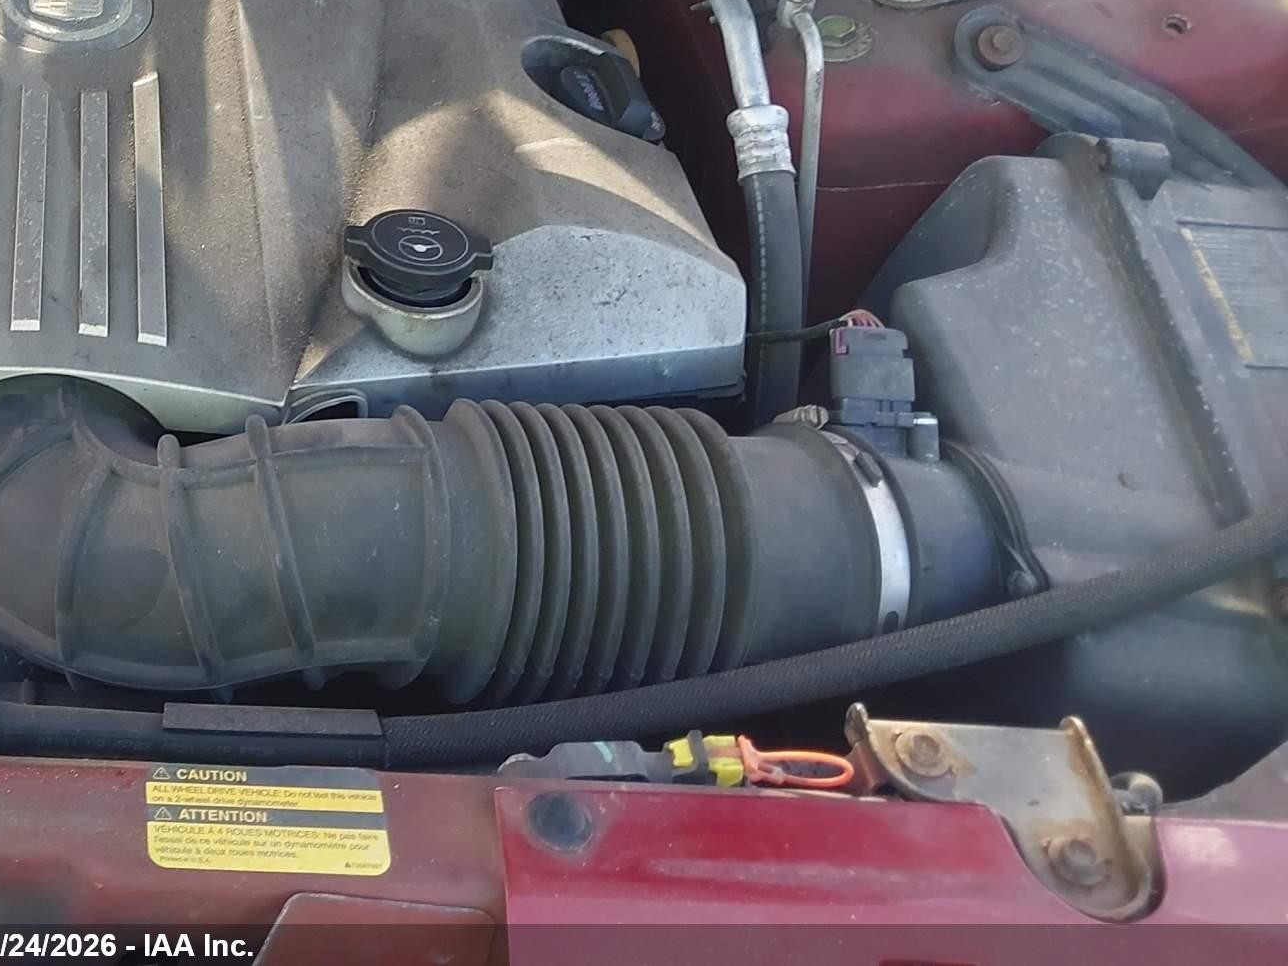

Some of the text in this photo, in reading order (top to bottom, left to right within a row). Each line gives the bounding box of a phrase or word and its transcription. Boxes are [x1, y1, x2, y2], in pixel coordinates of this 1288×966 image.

[176, 768, 248, 782] CAUTION
[152, 784, 170, 793] ALL
[171, 785, 205, 794] WHEEL
[207, 786, 238, 795] DRIVE
[283, 789, 296, 797] Do
[330, 792, 345, 800] this
[347, 792, 377, 800] vehicle
[174, 795, 211, 804] 2-wheel
[212, 796, 235, 804] drive
[178, 808, 268, 823] ATTENTION
[154, 824, 204, 835] VÉHICULE
[217, 827, 224, 835] 4
[225, 827, 262, 837] ROUES
[263, 829, 320, 839] MOTRICES:
[358, 832, 379, 841] faire
[185, 836, 197, 844] de
[213, 837, 251, 846] véhicule
[349, 843, 370, 851] pour
[196, 846, 202, 855] à
[203, 846, 226, 855] deux
[228, 849, 255, 857] roues
[257, 850, 298, 859] motrices.
